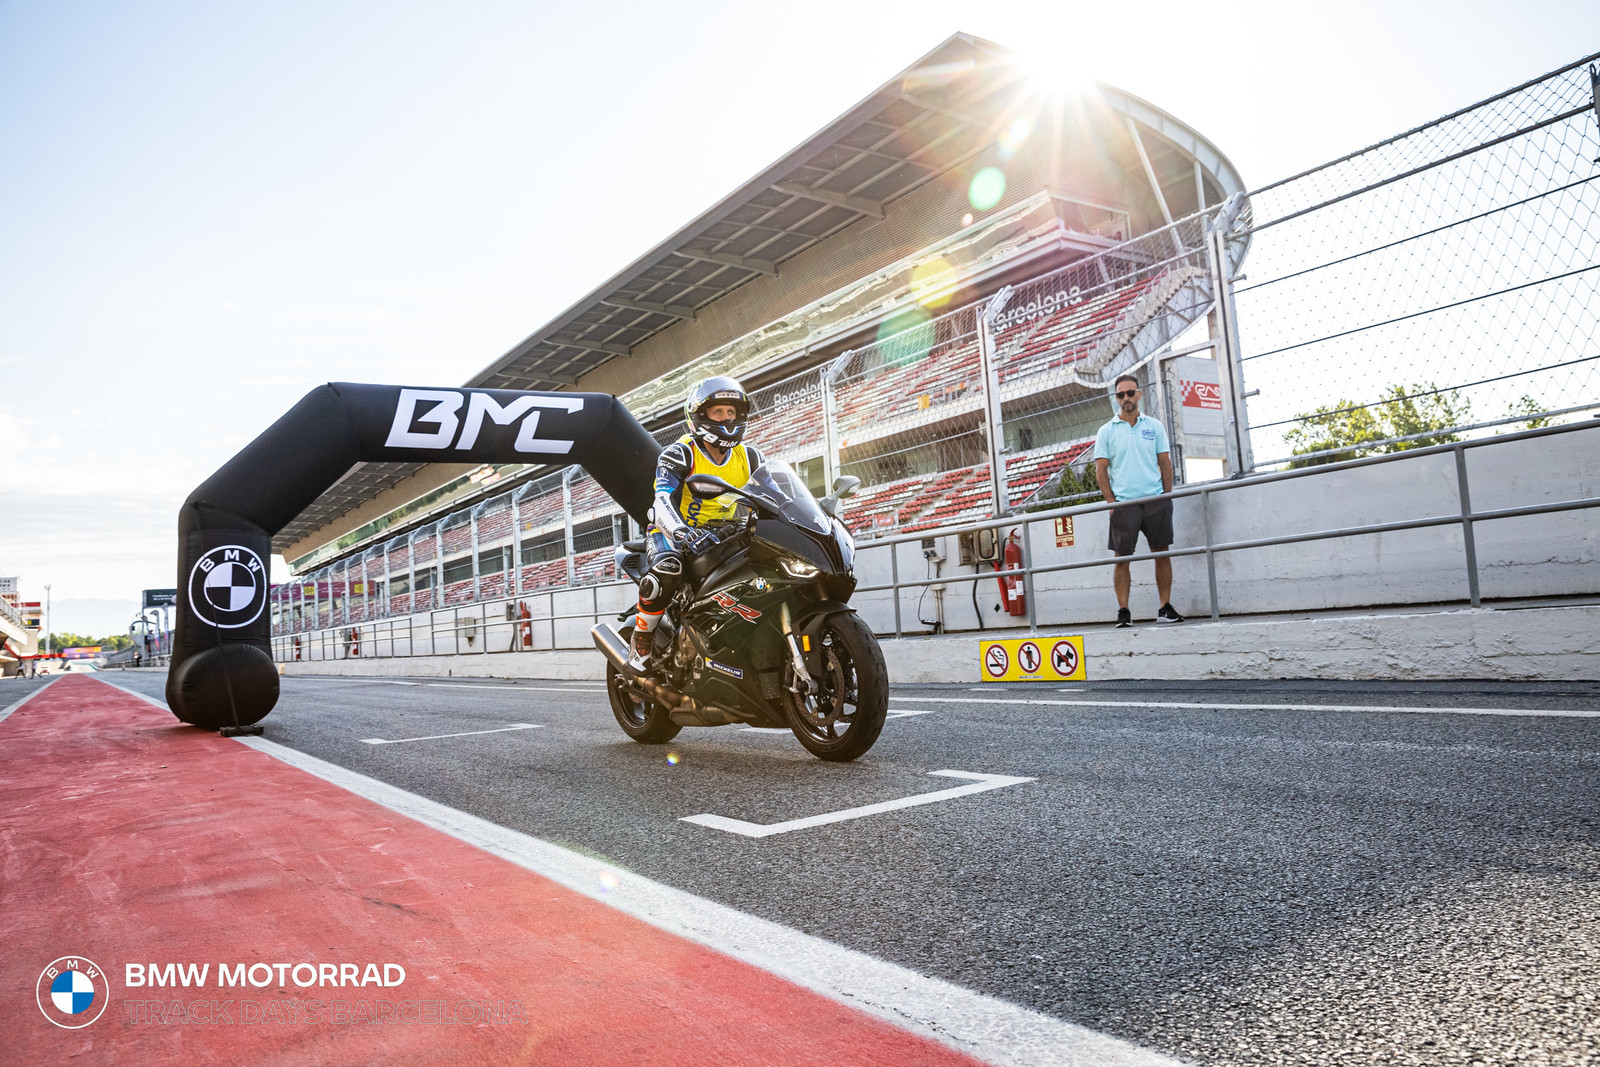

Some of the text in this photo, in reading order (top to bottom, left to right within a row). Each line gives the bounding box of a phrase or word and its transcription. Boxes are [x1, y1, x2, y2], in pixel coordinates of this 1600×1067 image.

[996, 286, 1083, 331] arcelona
[384, 388, 585, 455] BMC
[200, 549, 261, 573] BMW
[710, 591, 762, 625] RR
[712, 662, 741, 677] MICHELIN
